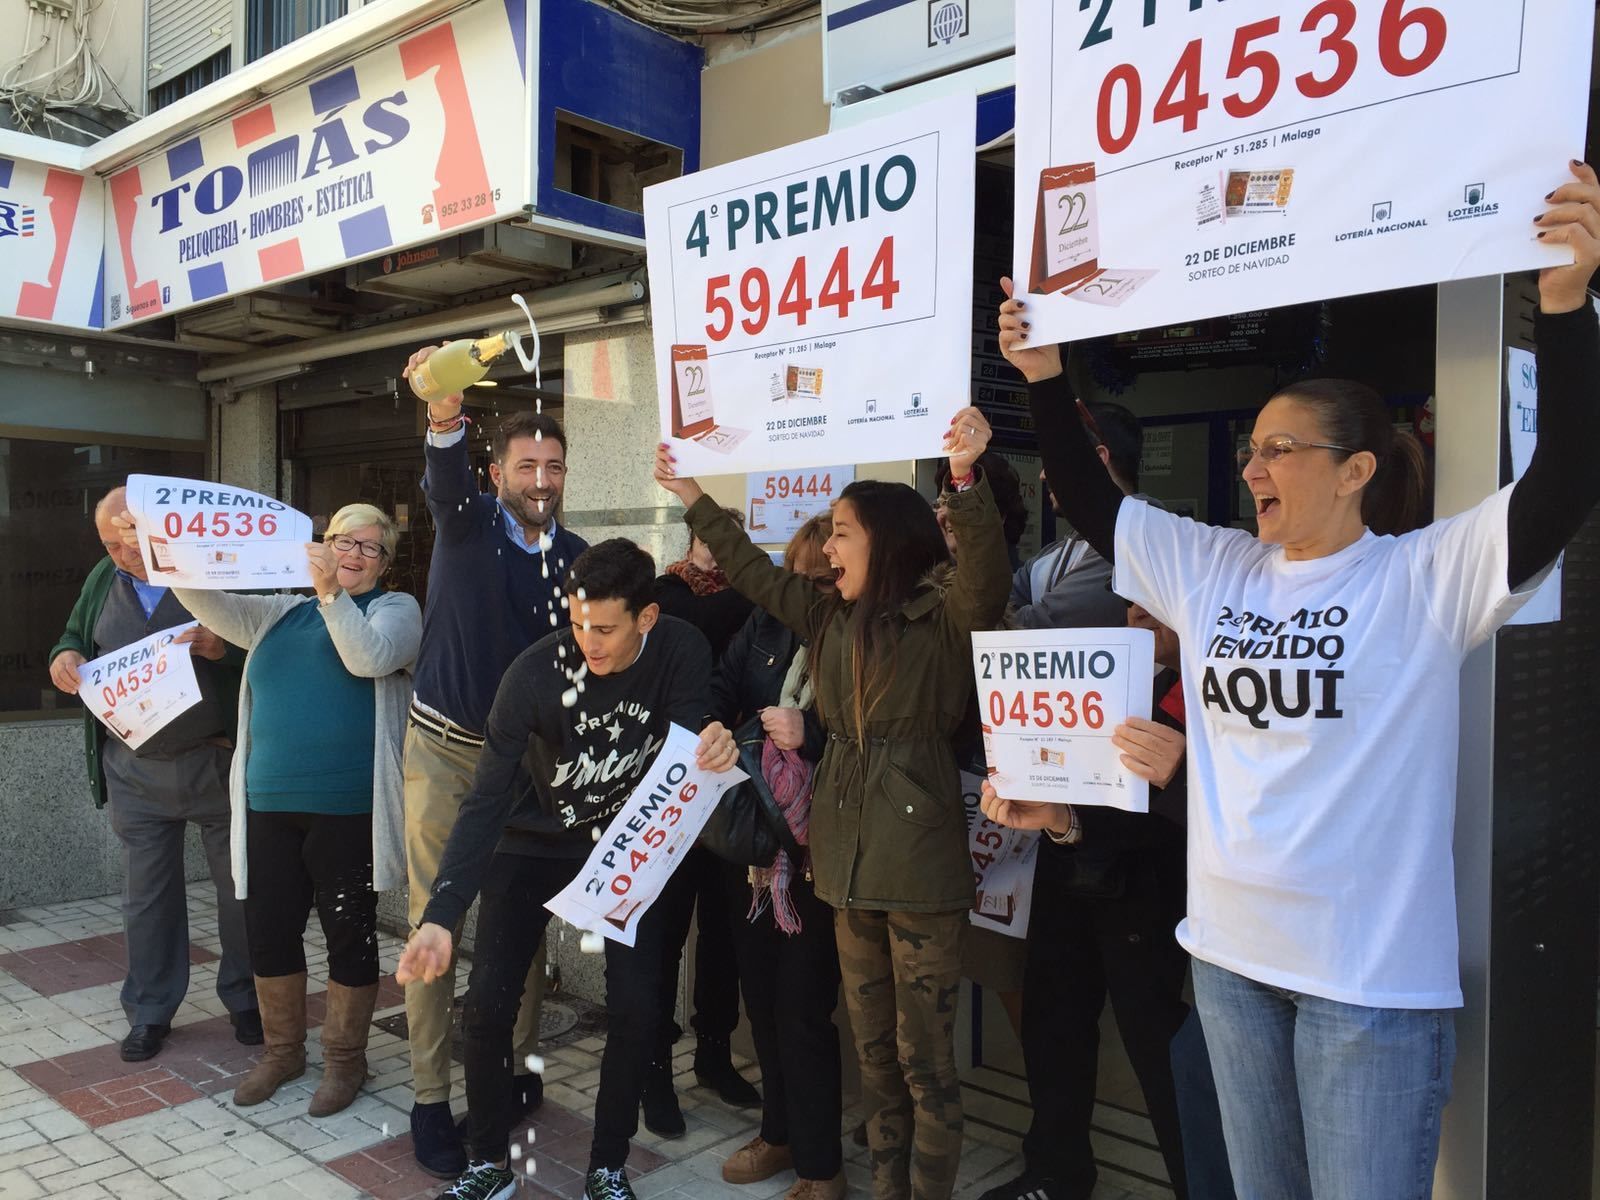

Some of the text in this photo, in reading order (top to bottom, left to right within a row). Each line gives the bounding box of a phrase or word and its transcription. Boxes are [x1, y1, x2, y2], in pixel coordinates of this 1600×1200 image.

[1096, 0, 1448, 155] 04536
[1175, 153, 1214, 170] Receptor
[1233, 138, 1268, 156] 51.285
[1281, 127, 1321, 144] Malaga
[178, 219, 239, 264] PELUQUERIA
[250, 196, 304, 240] HOMBRES
[316, 170, 375, 217] ESTÉTICA
[441, 187, 501, 217] 952 33 28 15
[685, 154, 917, 258] 4º PREMIO
[1058, 191, 1089, 236] 22
[1448, 202, 1499, 218] LOTERÍAS
[1058, 235, 1089, 253] Diciembre
[1335, 218, 1428, 242] LOTERÍA NACIONAL
[1185, 233, 1296, 266] 22 DE DICIEMBRE
[1188, 254, 1290, 281] SORTEO DE NAVIDAD
[704, 235, 900, 342] 59444
[685, 366, 706, 397] 22
[766, 415, 827, 430] 22 DE DICIEMBRE
[769, 433, 790, 442] SORTEO
[799, 429, 825, 439] NAVIDAD
[156, 487, 287, 511] 2º PREMIO
[765, 473, 833, 499] 59444
[1021, 482, 1036, 498] 78
[164, 511, 277, 539] 04536
[107, 634, 175, 678] PREMIO
[980, 650, 1116, 681] 2º PREMIO
[102, 653, 168, 708] 04536
[1202, 662, 1345, 729] AQUÍ
[989, 690, 1105, 730] 04536
[601, 762, 688, 869] PREMIO
[610, 782, 698, 896] 04536
